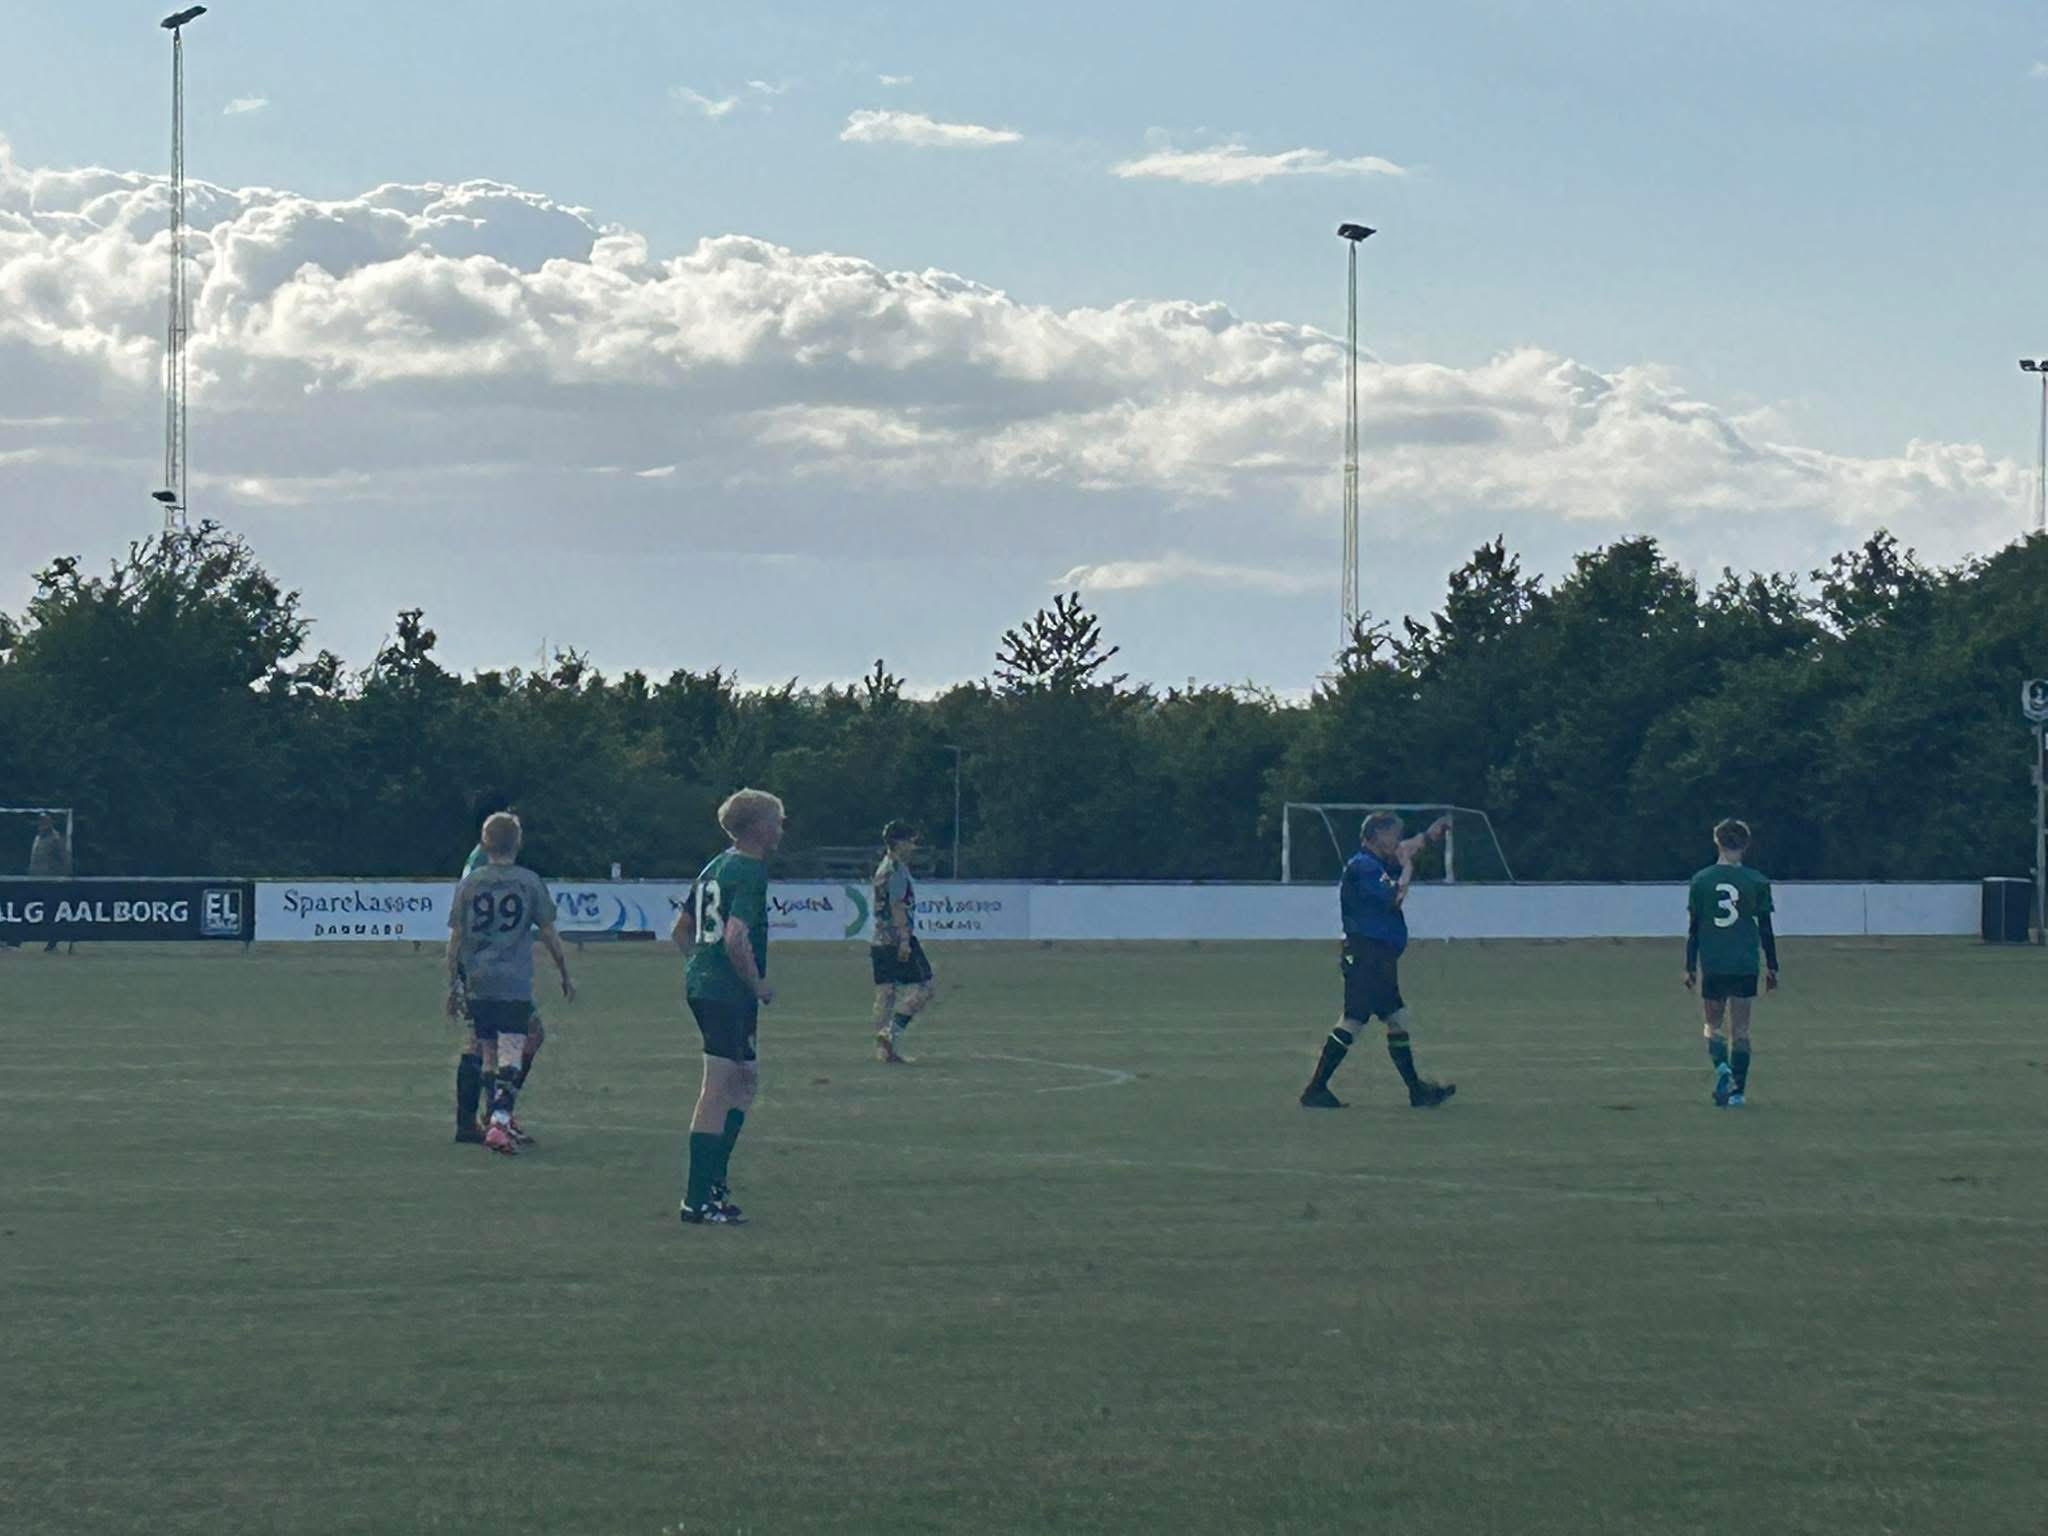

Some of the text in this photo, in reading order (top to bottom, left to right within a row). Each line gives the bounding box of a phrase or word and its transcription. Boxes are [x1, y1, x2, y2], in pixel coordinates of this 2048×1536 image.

[54, 900, 189, 923] AALBORG
[206, 893, 238, 918] EL
[471, 891, 524, 933] 99
[1713, 882, 1740, 928] 3
